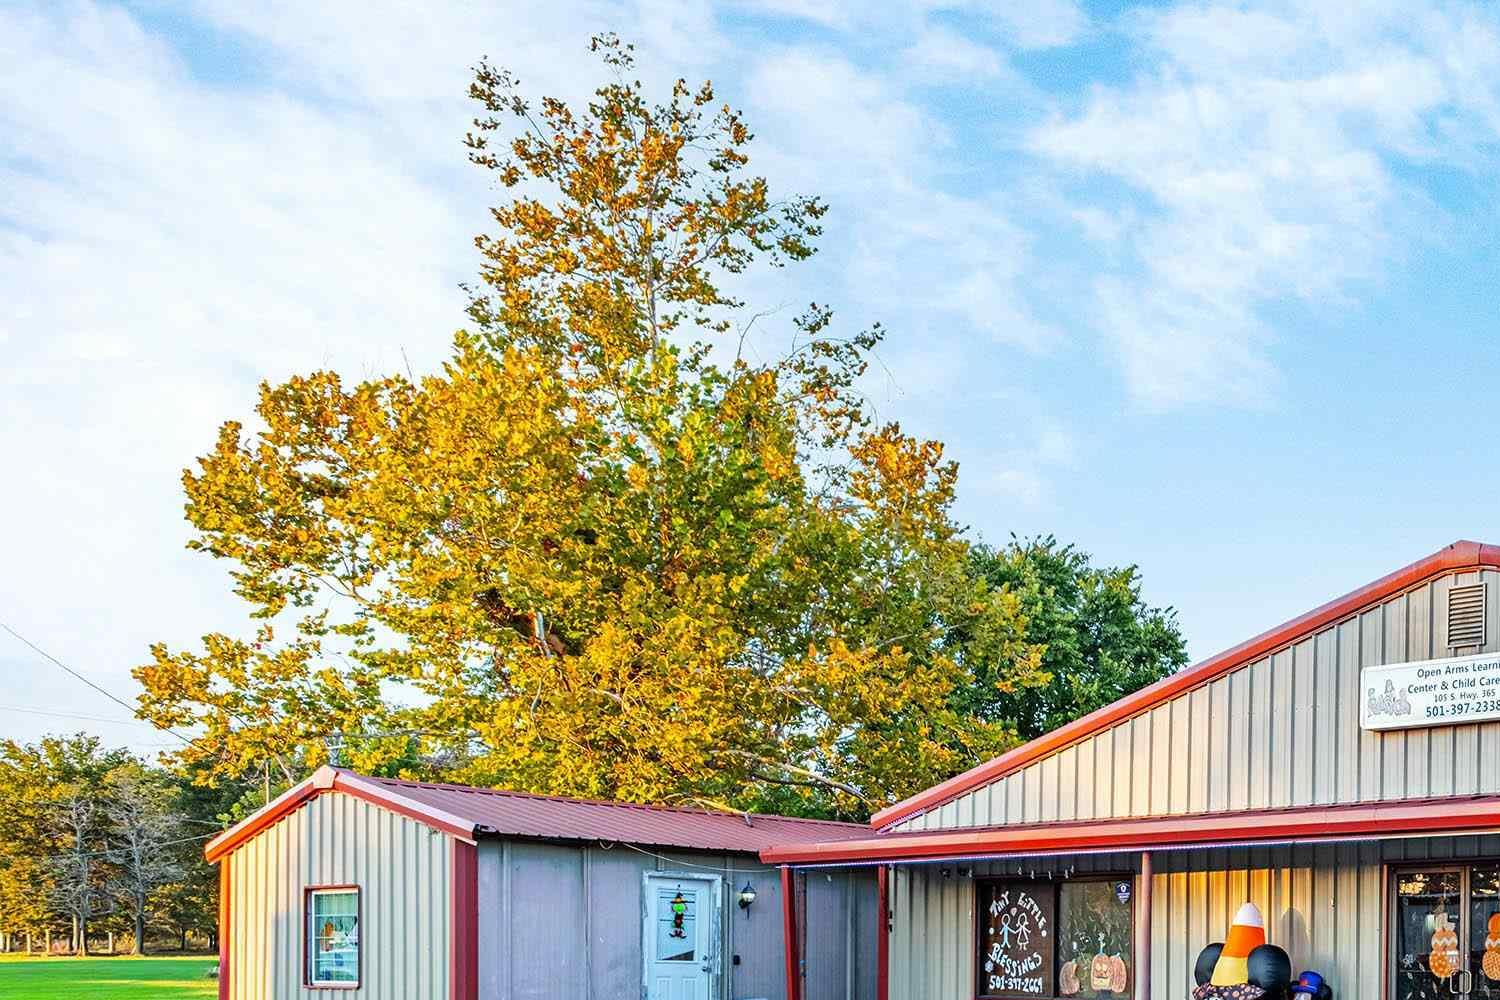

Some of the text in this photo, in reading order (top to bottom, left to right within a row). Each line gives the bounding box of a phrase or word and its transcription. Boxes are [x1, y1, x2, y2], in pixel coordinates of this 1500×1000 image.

[1417, 668, 1441, 679] Open
[1445, 665, 1469, 675] Arms
[1408, 683, 1437, 693] Center
[1440, 681, 1449, 690] &
[1452, 678, 1476, 689] Child
[1434, 693, 1448, 703] 105
[1460, 690, 1479, 701] Hwy.
[1482, 688, 1496, 698] 365
